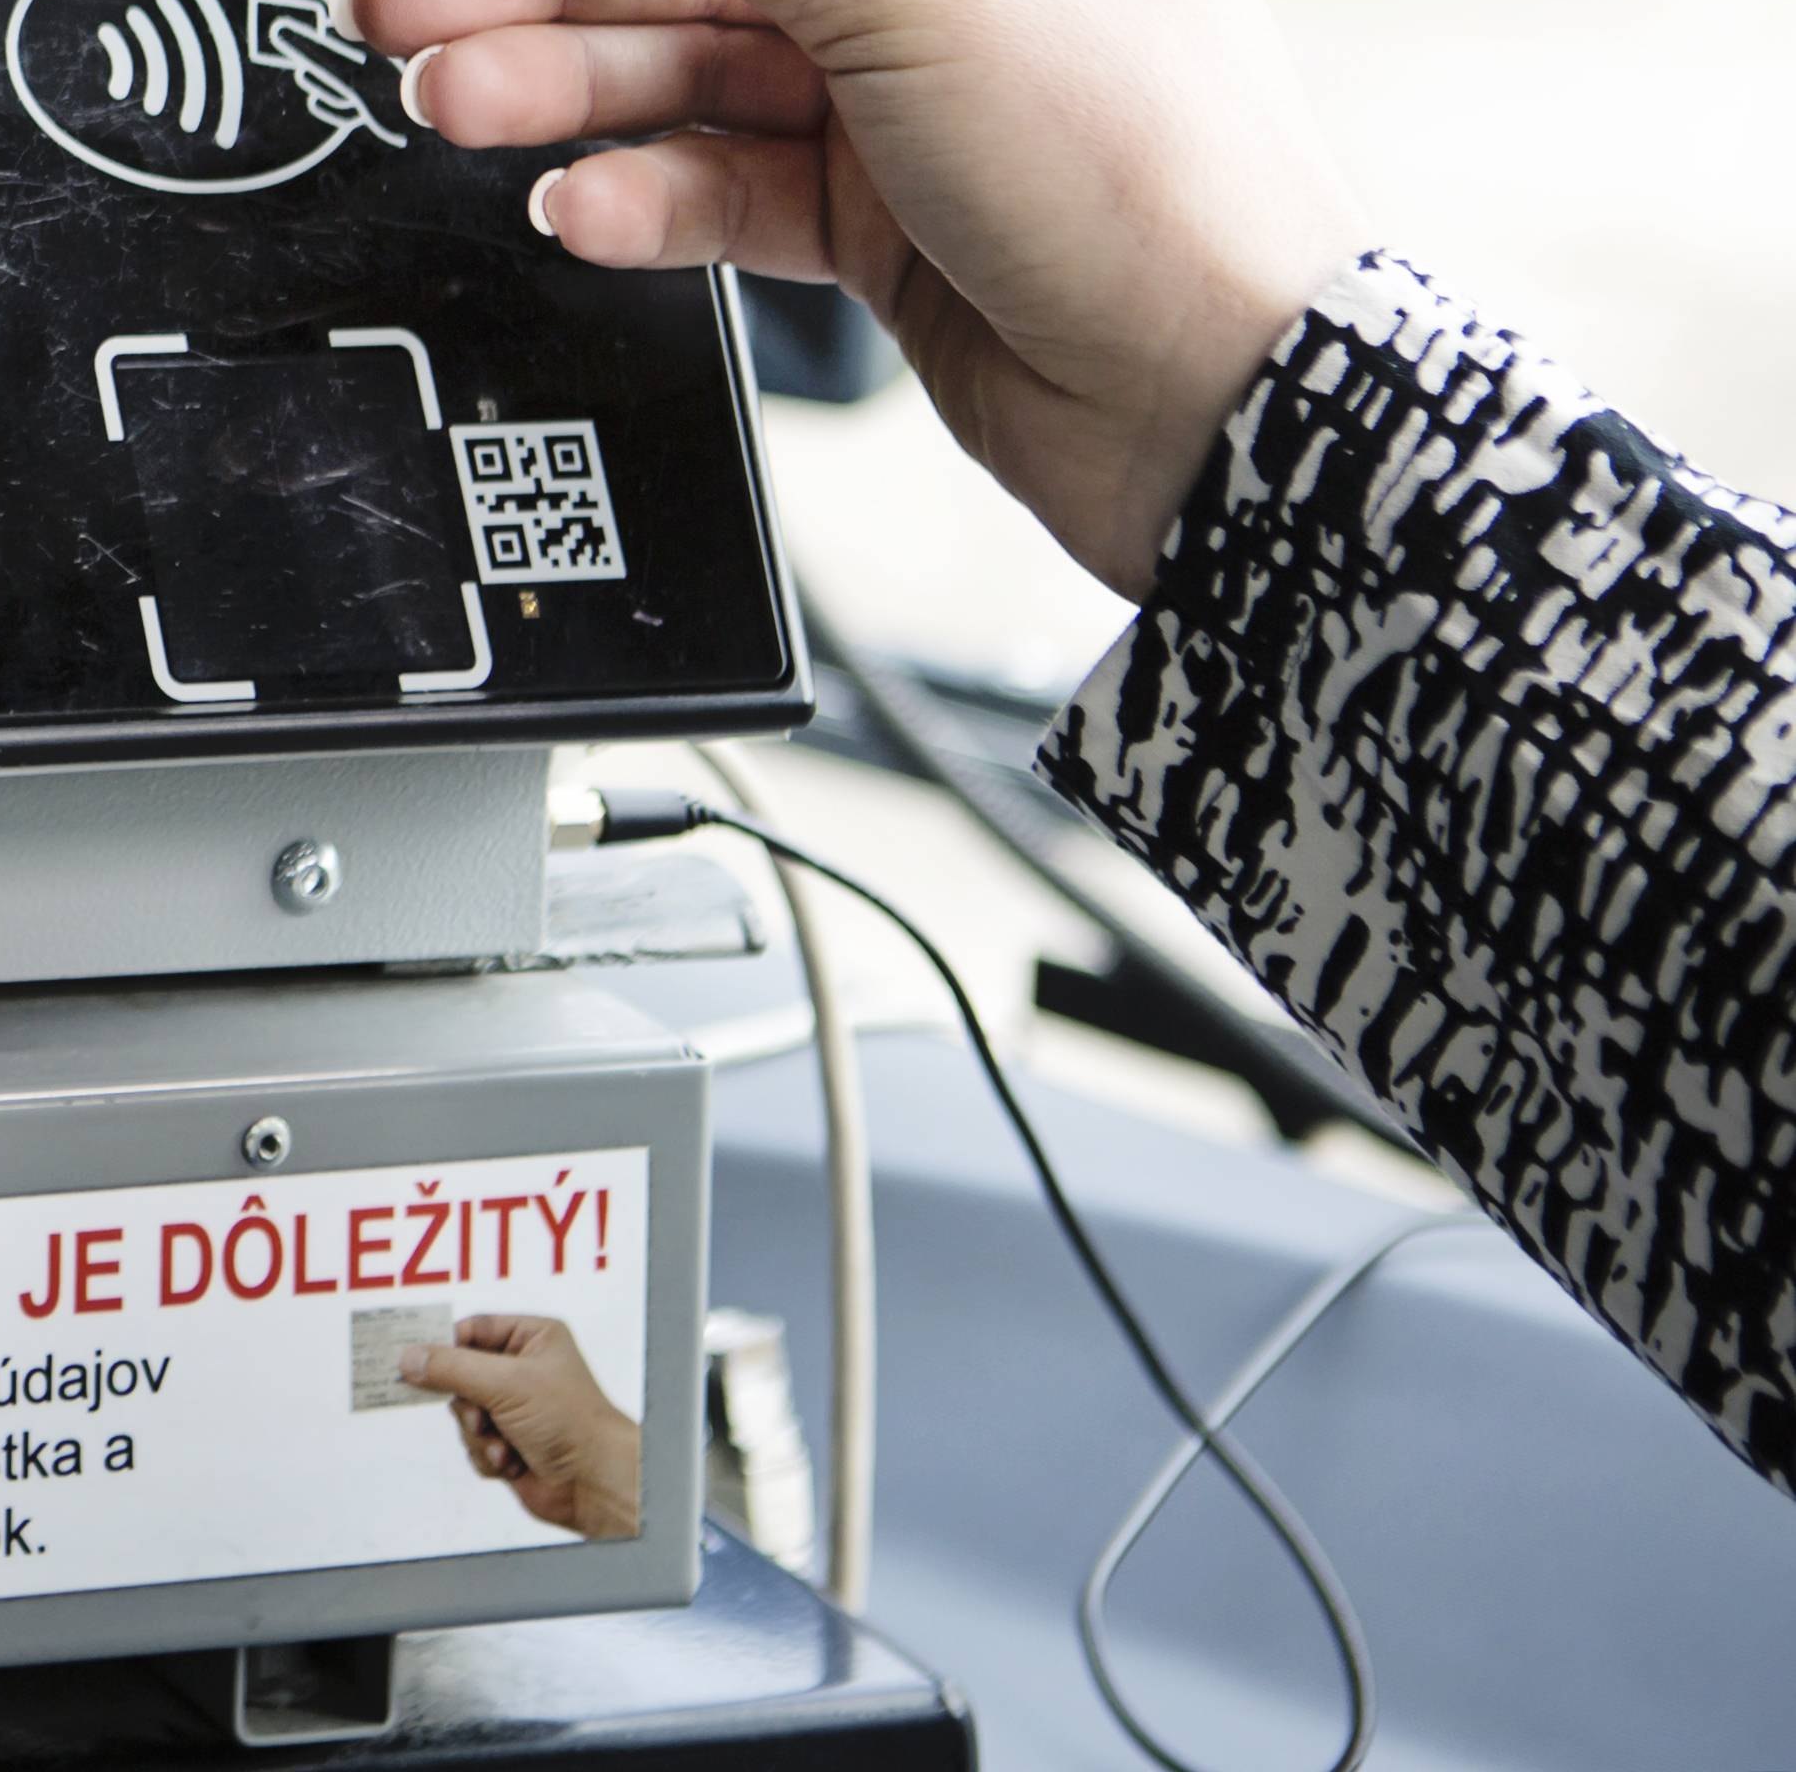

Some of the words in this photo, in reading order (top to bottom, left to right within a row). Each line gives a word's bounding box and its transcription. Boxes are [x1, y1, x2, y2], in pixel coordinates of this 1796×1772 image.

[19, 1228, 123, 1319] JE
[160, 1168, 609, 1307] DÔLEŽITÝ!
[104, 1434, 134, 1472] a
